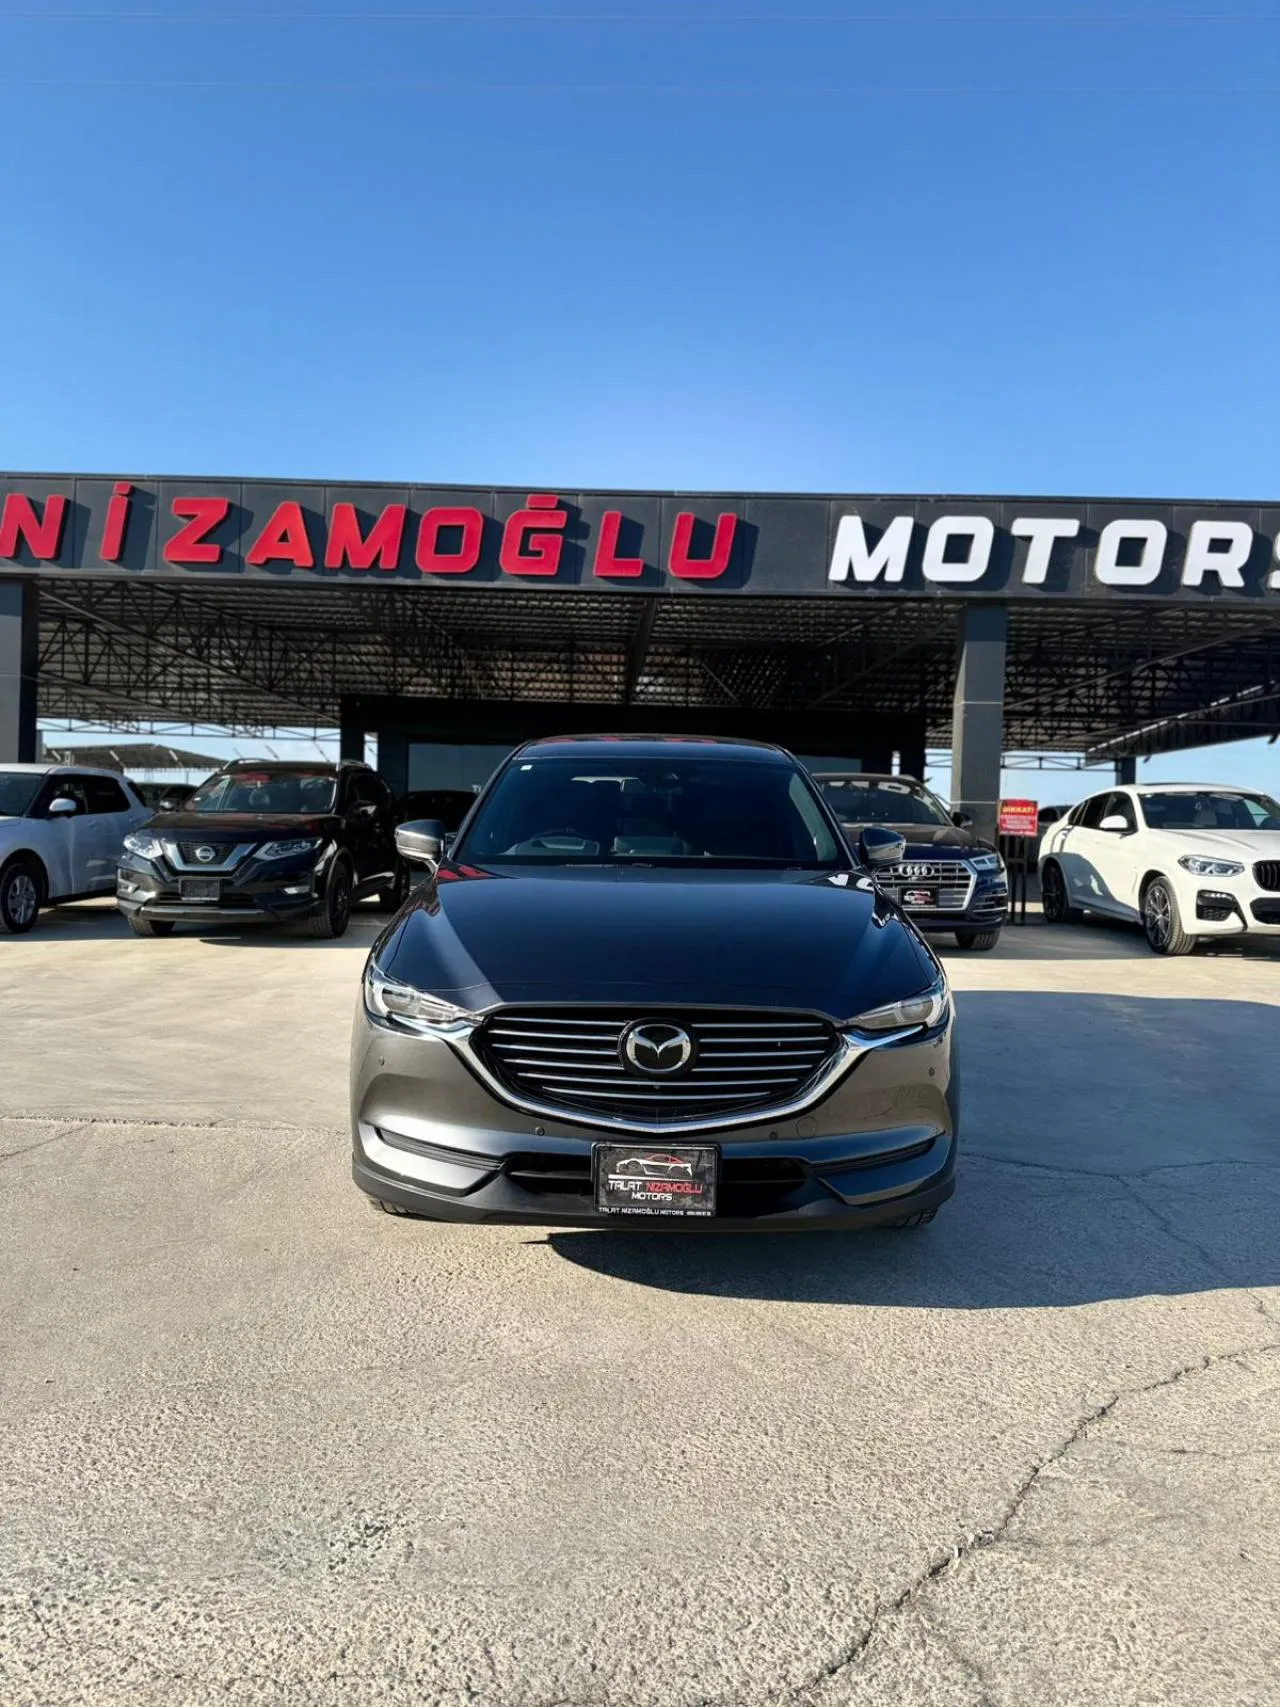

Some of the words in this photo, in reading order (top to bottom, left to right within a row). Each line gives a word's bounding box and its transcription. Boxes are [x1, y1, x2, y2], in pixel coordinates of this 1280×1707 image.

[0, 482, 737, 580] NİZAMOĞLU
[828, 515, 1280, 590] MOTOR
[608, 1180, 642, 1191] TALAT
[631, 1192, 673, 1201] MOTORS
